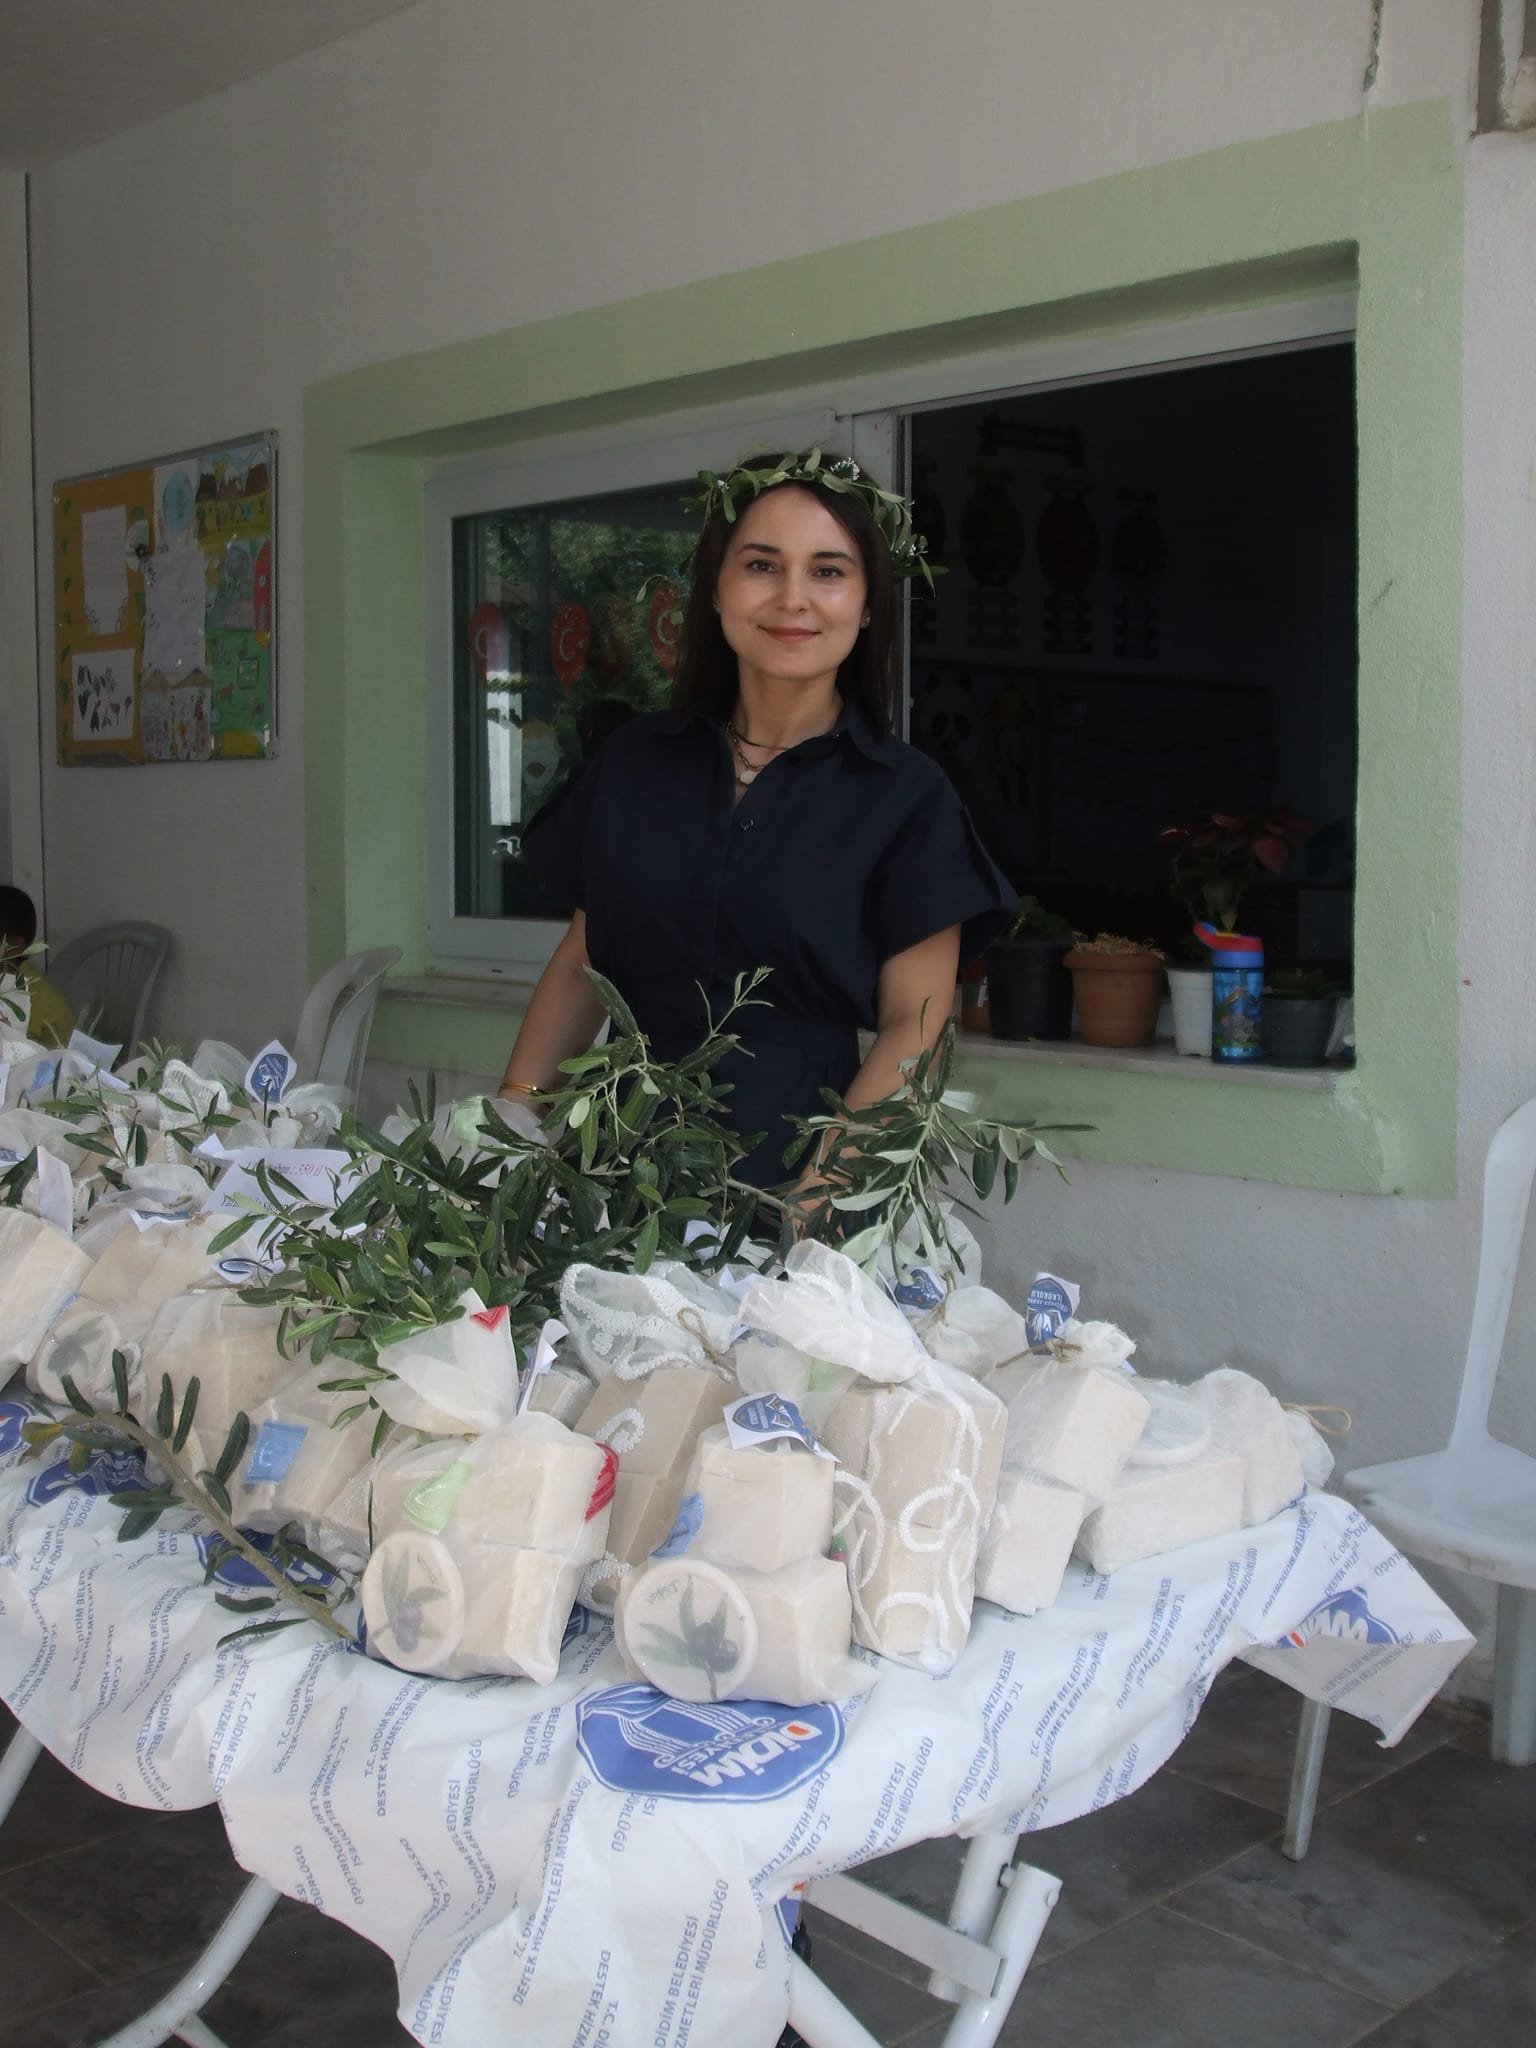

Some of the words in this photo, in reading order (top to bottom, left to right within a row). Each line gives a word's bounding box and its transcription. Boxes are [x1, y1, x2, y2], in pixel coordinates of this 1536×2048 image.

[998, 1649, 1016, 1683] DESTEK
[157, 1694, 173, 1732] DİDİM
[227, 1713, 248, 1752] DİDİM
[243, 1692, 256, 1713] T.C.
[286, 1688, 301, 1728] DİDİM
[381, 1702, 418, 1762] HİZMETLERİ
[1036, 1702, 1059, 1738] DİDİM
[1044, 1689, 1083, 1759] HİZMETLERİ
[208, 1699, 235, 1774] HİZMETLERİ
[364, 1756, 376, 1778] T.C.
[370, 1718, 390, 1753] DİDİM
[507, 1725, 537, 1799] MÜDÜRLÜĞÜ
[689, 1720, 822, 1787] DİDİM
[376, 1763, 388, 1817] DESTEK
[462, 1739, 483, 1828] MÜDÜRLÜĞÜ
[807, 1771, 831, 1814] DESTEK
[873, 1760, 908, 1829] BELEDİYESİ
[899, 1736, 935, 1812] MÜDÜRLÜĞÜ
[322, 1798, 363, 1867] BELEDİYESİ
[815, 1812, 831, 1831] T.C.
[323, 1824, 364, 1907] MÜDÜRLÜĞÜ
[400, 1837, 429, 1881] DESTEK
[531, 1861, 565, 1953] HİZMETLERİ
[694, 1878, 729, 1976] MÜDÜRLÜĞÜ
[429, 1958, 463, 2046] BELEDİYESİ
[587, 1949, 611, 2010] DESTEK
[654, 2001, 677, 2048] DİDİM
[668, 1914, 700, 1999] BELEDİYESİ
[602, 2000, 619, 2025] T.C.
